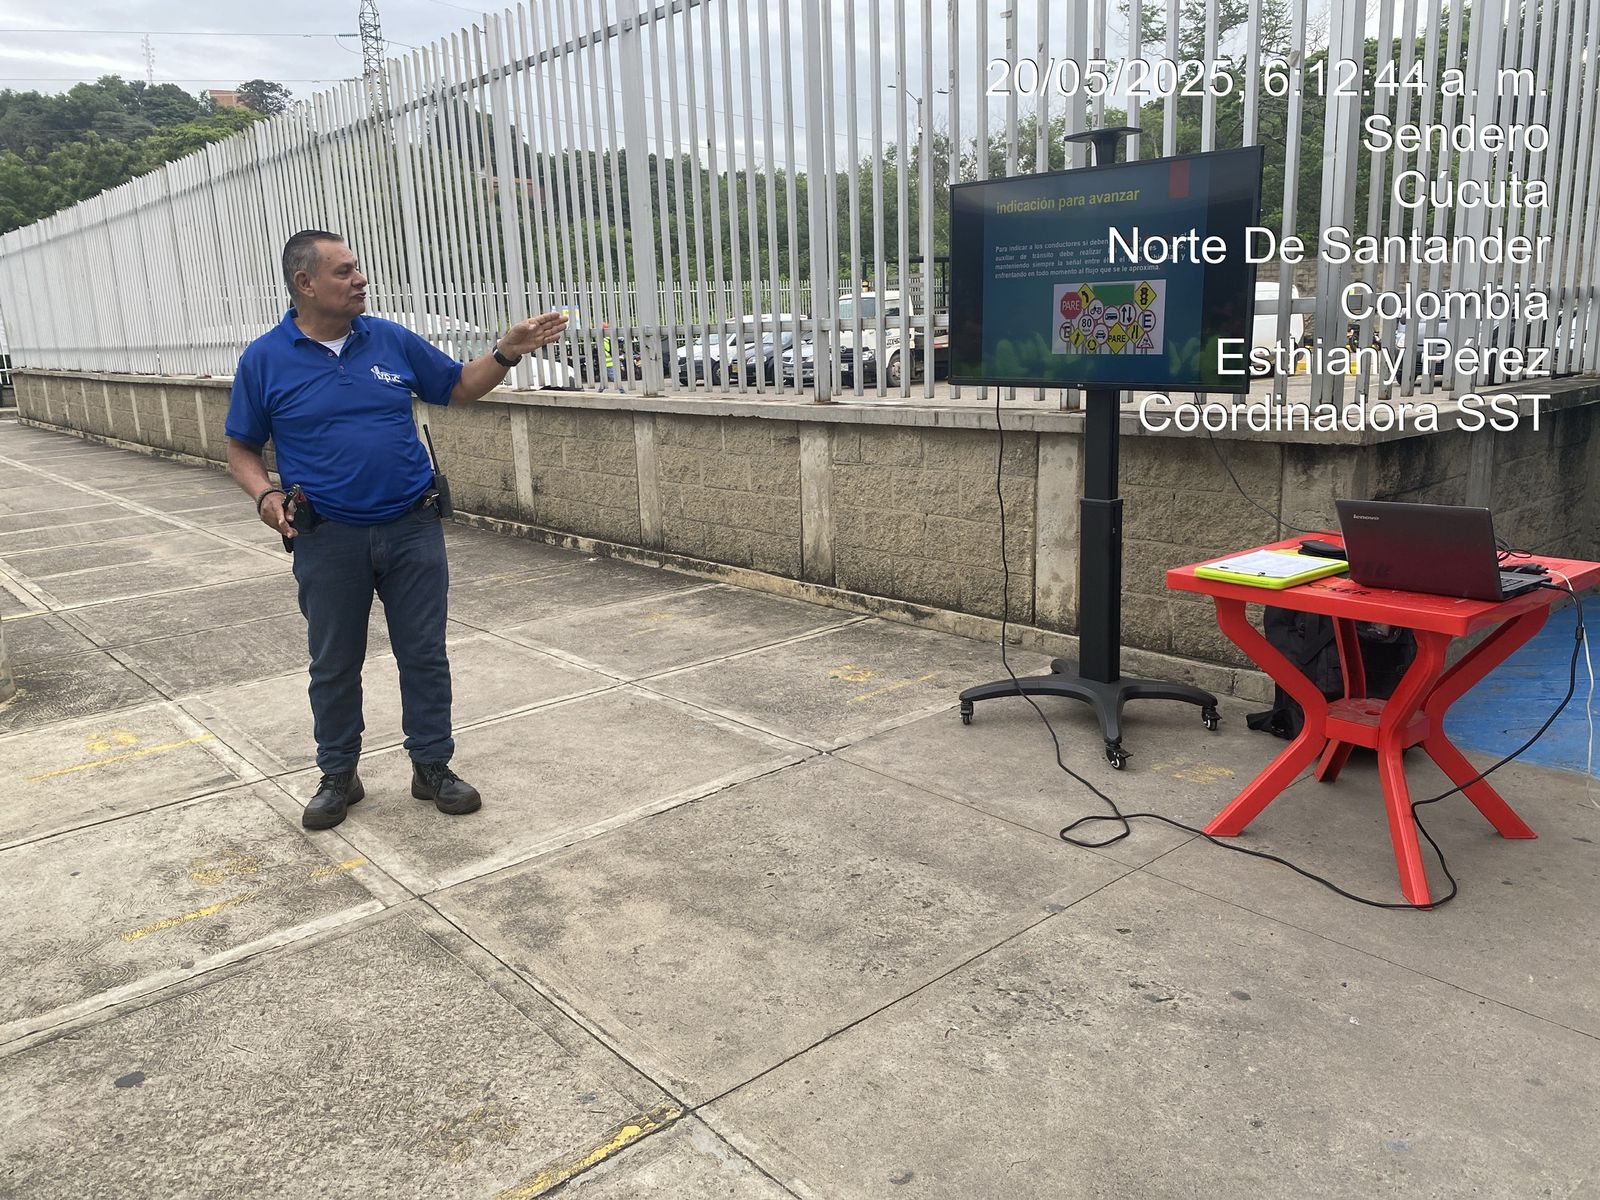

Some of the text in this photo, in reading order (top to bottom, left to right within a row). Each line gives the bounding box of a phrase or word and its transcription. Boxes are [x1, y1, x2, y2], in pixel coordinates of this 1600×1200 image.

[1058, 195, 1086, 211] para
[1088, 189, 1140, 205] avanzar
[1044, 240, 1080, 249] conductores
[1080, 247, 1102, 256] realizar
[1032, 260, 1054, 268] siempre
[995, 270, 1028, 278] enfrentando
[1050, 268, 1078, 276] momento
[1085, 266, 1098, 275] flujo
[1100, 266, 1112, 275] que
[1062, 301, 1080, 310] PARE
[1082, 318, 1092, 328] 80
[1144, 314, 1152, 328] E
